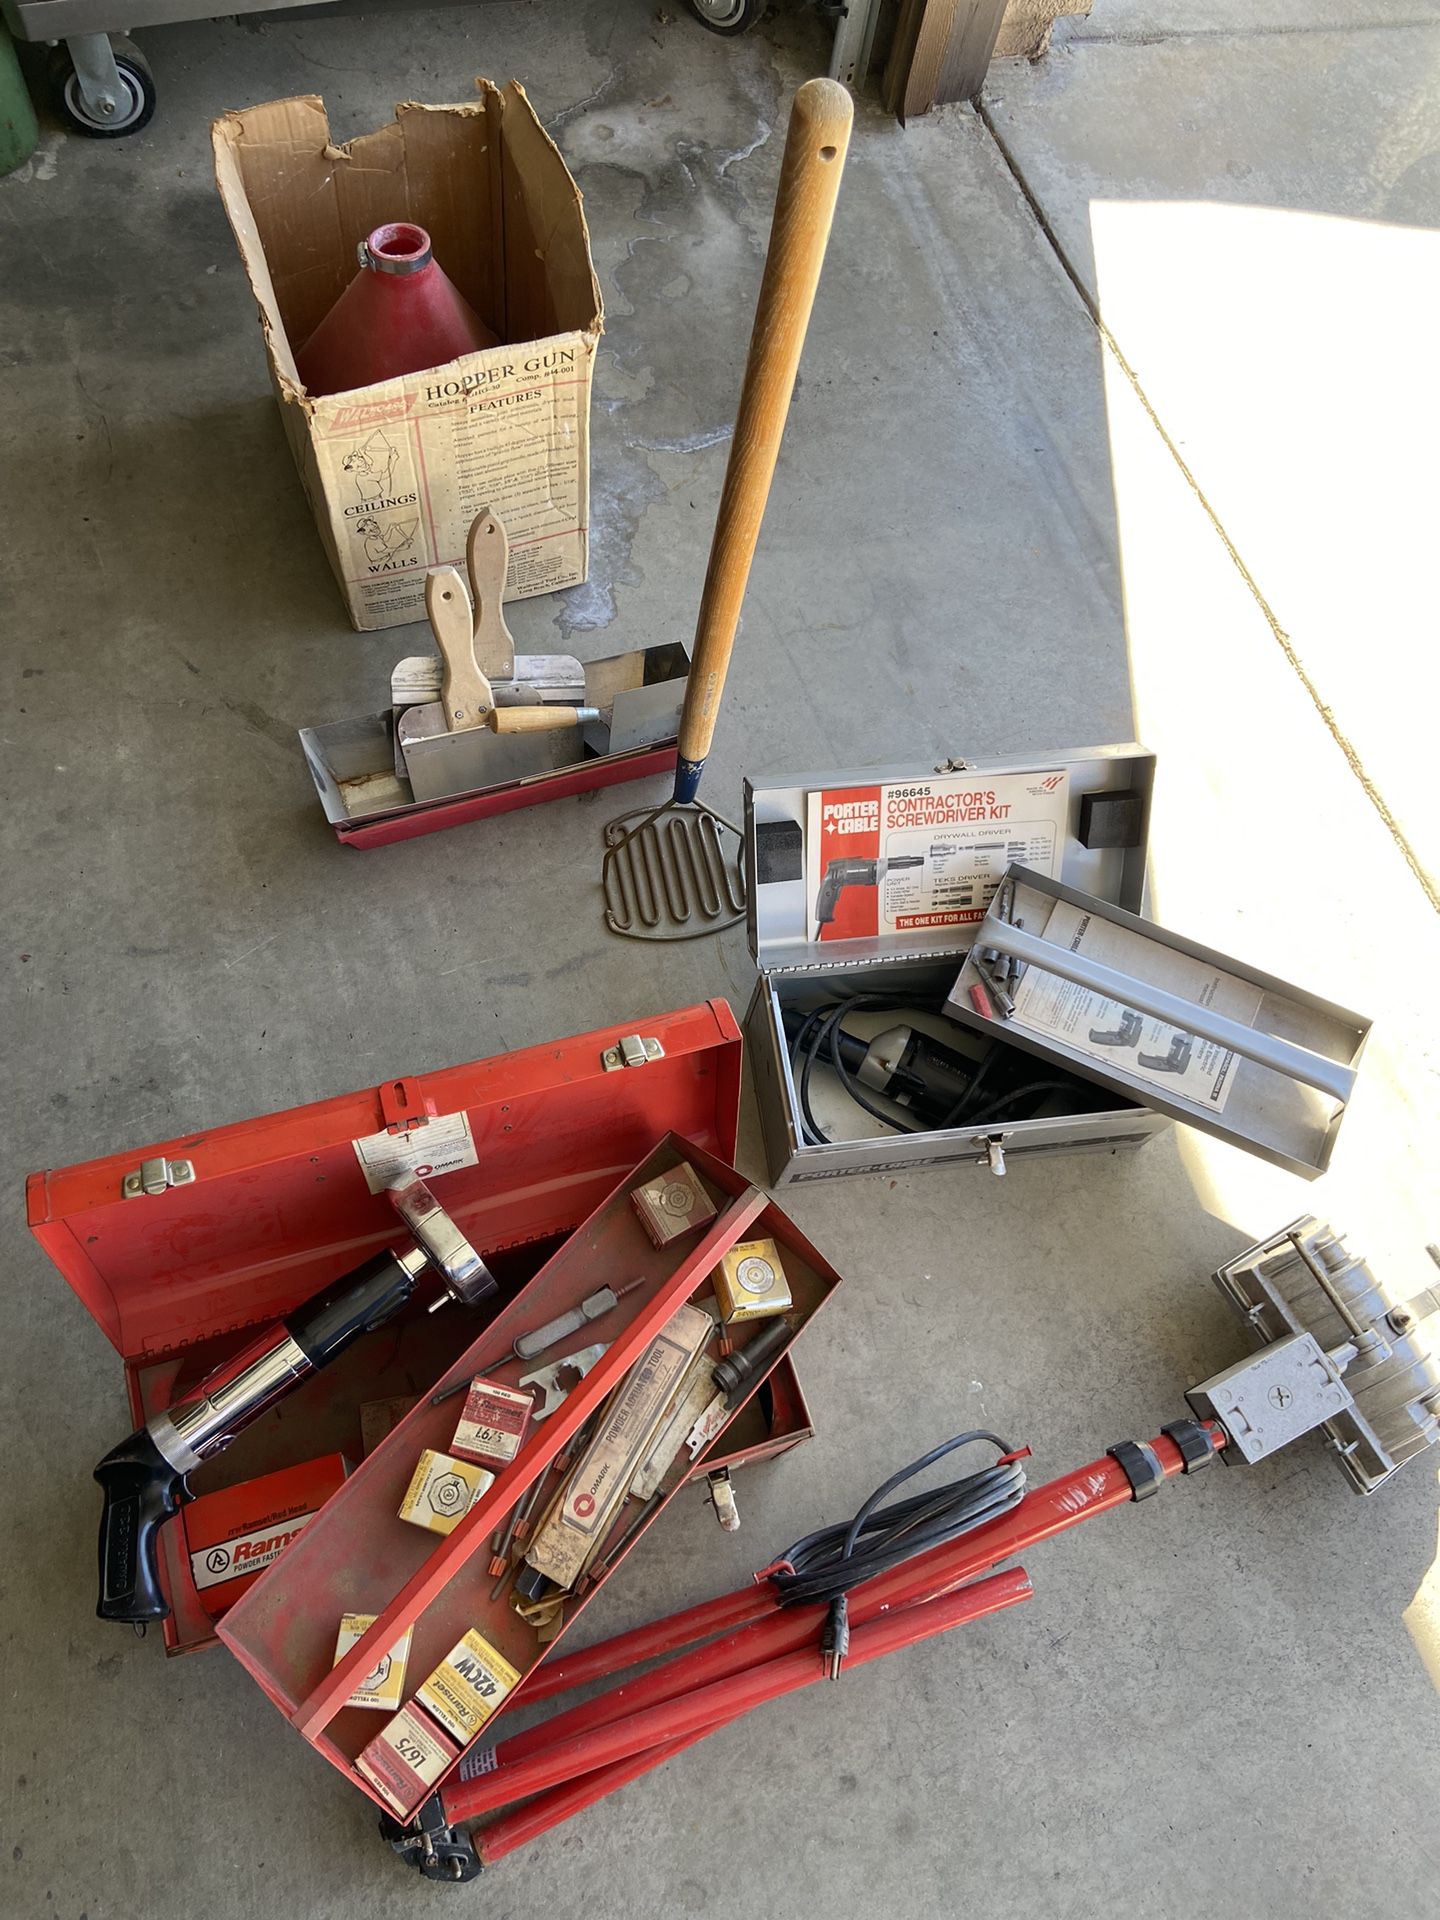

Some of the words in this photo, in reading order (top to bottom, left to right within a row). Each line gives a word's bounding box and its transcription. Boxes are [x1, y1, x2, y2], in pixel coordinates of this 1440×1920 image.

[426, 364, 515, 401] HOPPER
[524, 349, 575, 372] GUN
[428, 398, 460, 408] Catalog
[469, 389, 542, 414] FEATURES
[344, 493, 417, 517] CEILINGS
[368, 557, 418, 573] WALLS
[887, 787, 931, 800] #96645
[887, 791, 996, 814] CONTRACTOR'S
[823, 800, 879, 821] PORTER
[886, 807, 988, 829] SCREWDRIVER
[989, 805, 1012, 820] KIT
[837, 817, 879, 835] CABLE
[934, 830, 976, 841] DRYWALL
[978, 828, 1012, 837] DRIVER
[957, 873, 990, 881] DRIVER
[900, 918, 914, 927] THE
[915, 916, 929, 926] ONE
[930, 915, 943, 924] KIT
[944, 914, 959, 923] FOR
[960, 912, 973, 922] ALL
[434, 1158, 464, 1170] OMARK
[606, 1407, 630, 1444] POWDER
[649, 1347, 665, 1375] TOOL
[589, 1462, 611, 1495] OMARK
[234, 1557, 261, 1572] POWDER
[454, 1656, 497, 1698] 42CW
[433, 1681, 470, 1718] Ramset
[432, 1703, 451, 1723] YELLOW
[395, 1738, 426, 1769] L675
[374, 1750, 407, 1790] Ramset
[373, 1777, 384, 1788] RED
